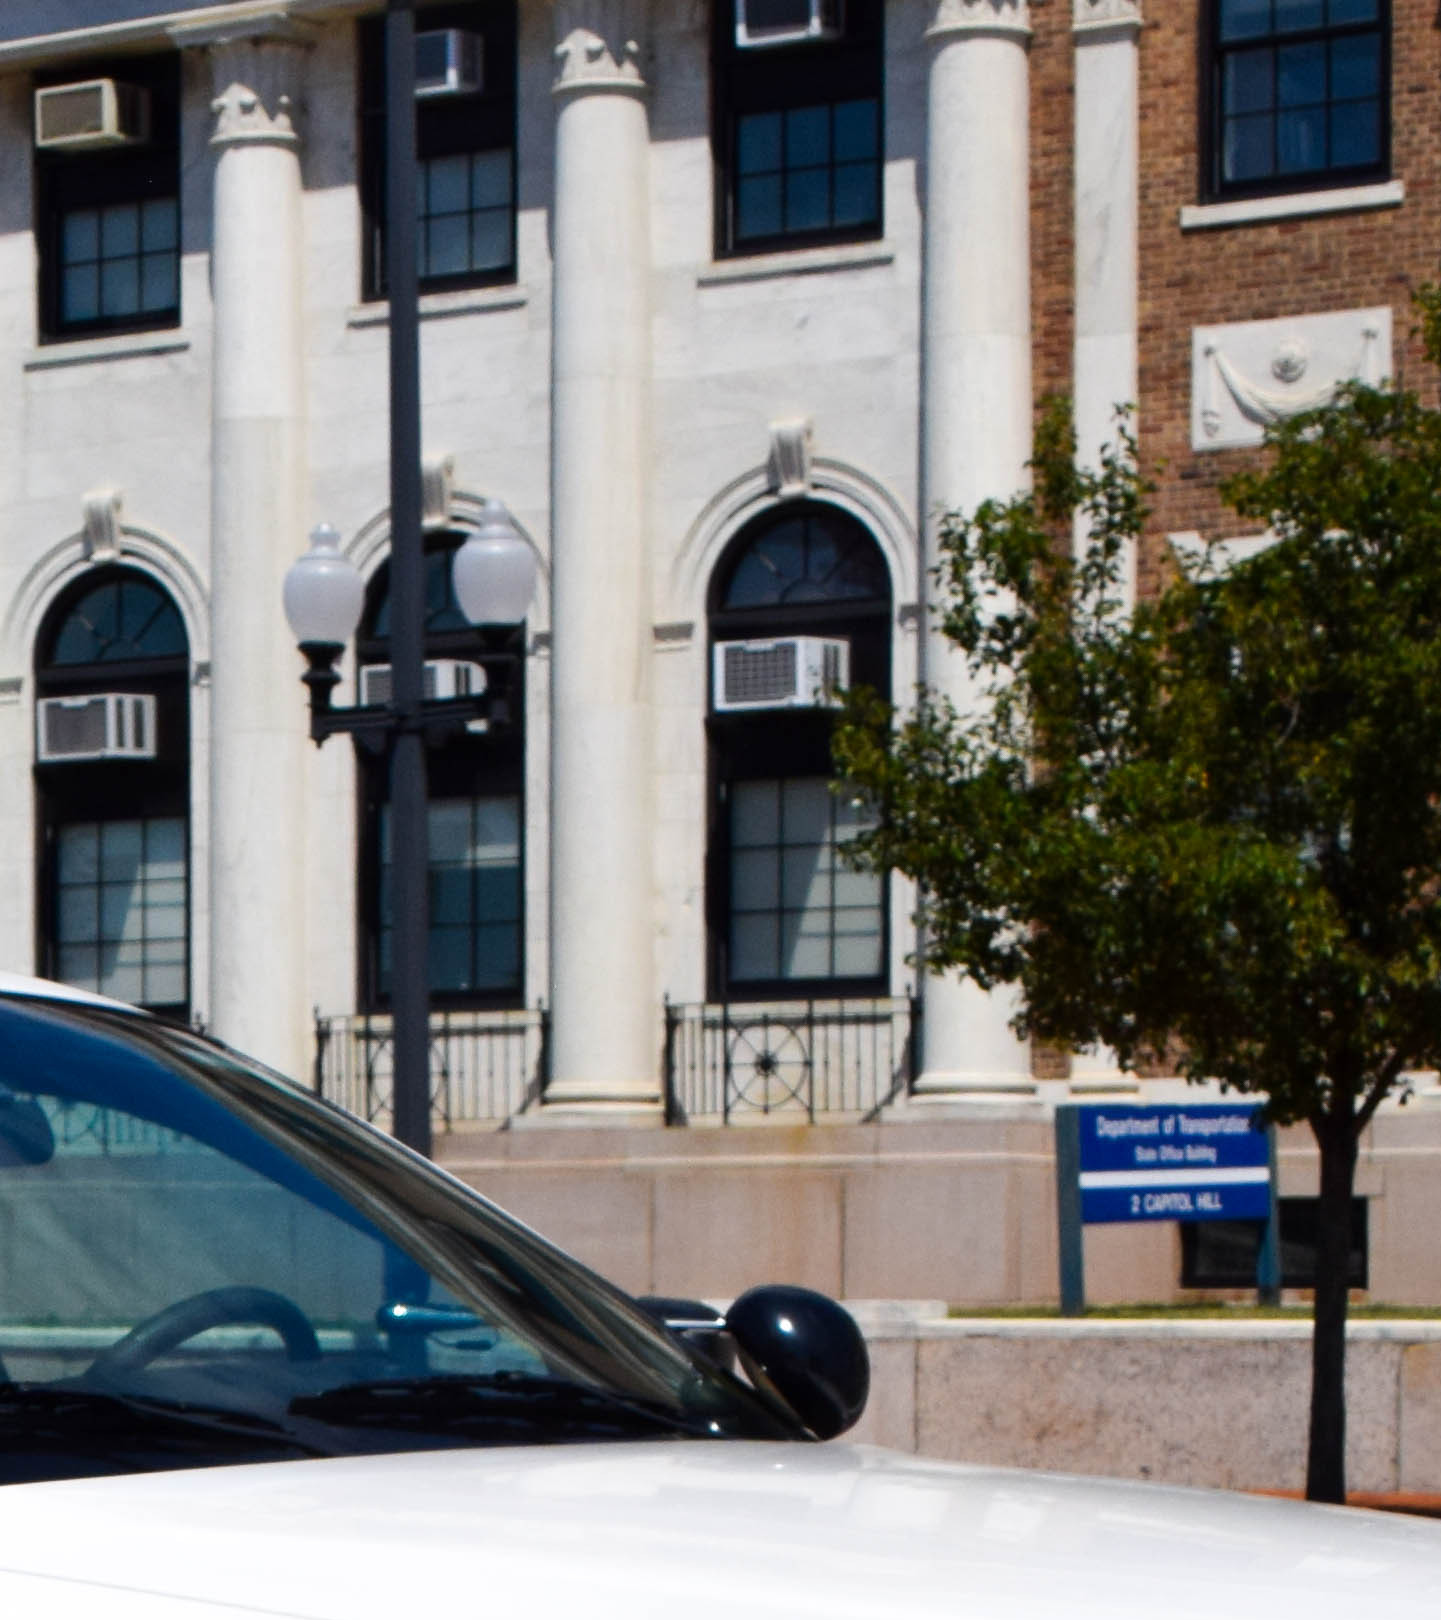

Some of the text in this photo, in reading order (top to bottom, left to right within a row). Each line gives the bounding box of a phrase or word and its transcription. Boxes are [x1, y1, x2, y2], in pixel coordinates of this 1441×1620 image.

[1096, 1115, 1159, 1138] Department
[1163, 1115, 1175, 1135] of
[1135, 1146, 1157, 1162] State
[1160, 1144, 1183, 1161] Office
[1131, 1192, 1222, 1214] 2 CAPITOL HILL
